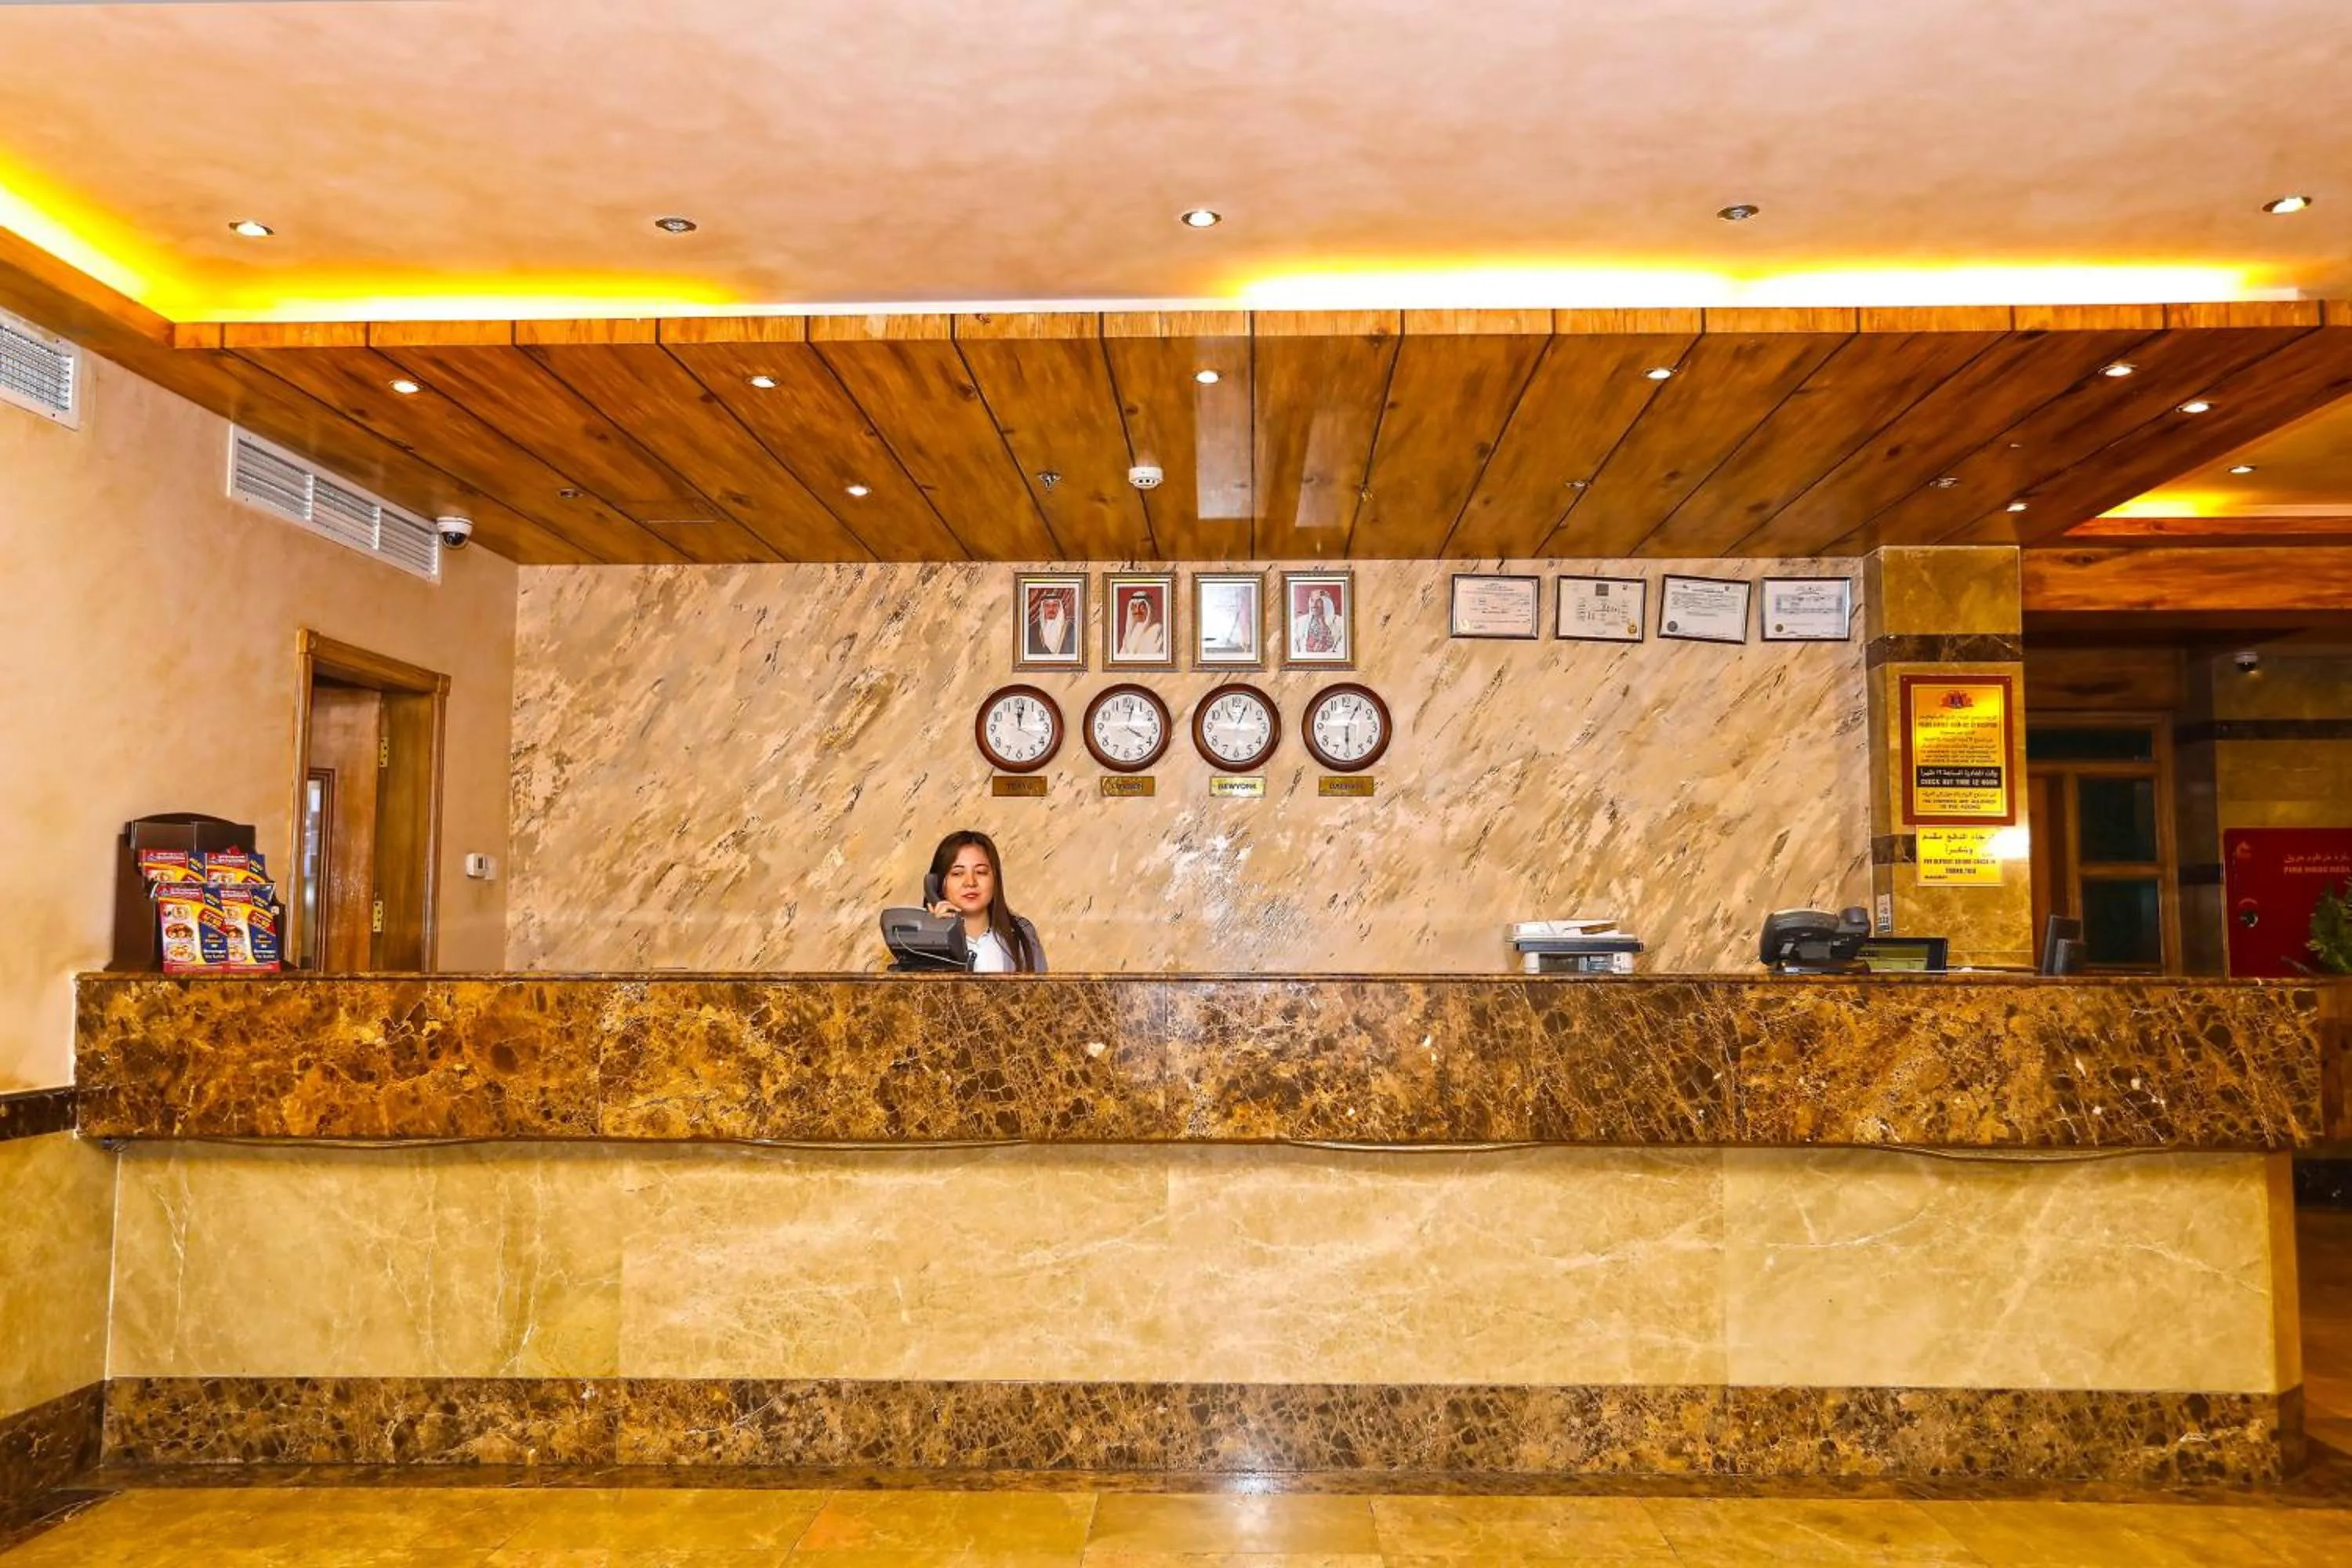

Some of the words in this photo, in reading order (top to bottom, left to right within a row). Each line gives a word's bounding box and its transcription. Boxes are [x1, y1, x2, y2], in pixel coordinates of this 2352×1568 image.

[1232, 697, 1242, 708] 12
[1330, 700, 1337, 711] 11
[1341, 696, 1350, 708] 12
[994, 711, 1003, 722] 10
[1039, 710, 1045, 721] 2
[1102, 710, 1111, 720] 10
[1146, 710, 1153, 721] 2
[1211, 710, 1220, 720] 10
[1256, 710, 1262, 720] 2
[1321, 710, 1330, 720] 10
[1366, 708, 1373, 720] 2
[989, 724, 996, 735] 9
[1044, 722, 1049, 734] 3
[1098, 722, 1104, 733] 9
[1152, 722, 1157, 734] 3
[1207, 722, 1214, 733] 9
[1261, 722, 1267, 734] 3
[1317, 722, 1324, 732] 9
[1372, 721, 1377, 733] 3
[995, 737, 1001, 748] 8
[1039, 737, 1044, 746] 4
[1102, 735, 1109, 746] 8
[1146, 736, 1152, 746] 4
[1211, 735, 1218, 746] 8
[1255, 736, 1261, 746] 4
[1322, 735, 1329, 746] 8
[1367, 735, 1373, 745] 4
[1006, 746, 1011, 756] 7
[1029, 746, 1036, 756] 5
[1112, 744, 1119, 755] 7
[1123, 748, 1130, 758] 6
[1137, 745, 1144, 756] 5
[1222, 744, 1229, 755] 7
[1233, 747, 1240, 758] 6
[1247, 745, 1253, 755] 5
[1333, 744, 1339, 754] 7
[1358, 743, 1364, 754] 5
[1016, 750, 1023, 759] 6
